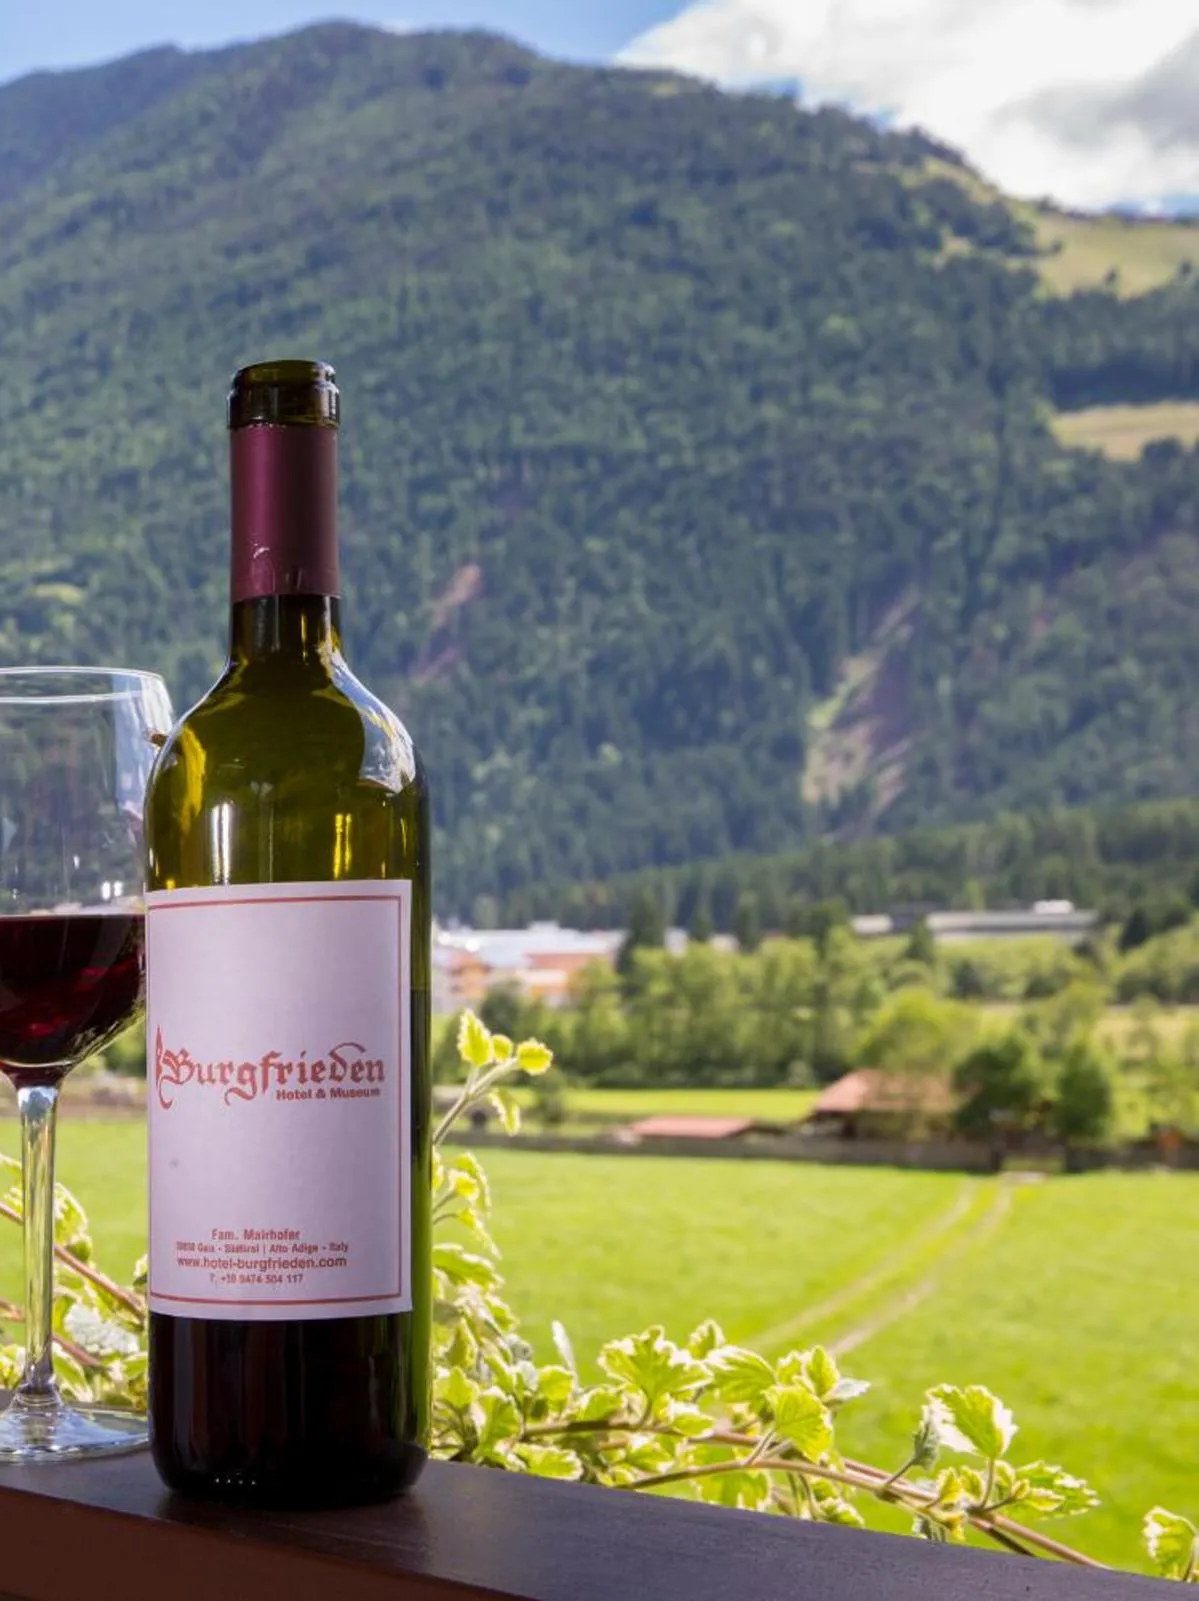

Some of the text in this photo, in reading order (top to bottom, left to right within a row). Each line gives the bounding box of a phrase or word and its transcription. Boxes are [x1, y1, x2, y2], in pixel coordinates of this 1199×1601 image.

[155, 1024, 385, 1110] Burgfrieden
[276, 1086, 381, 1101] Hotel & Museum
[211, 1228, 301, 1241] Fam. Mairhofer
[269, 1243, 288, 1254] Alto
[177, 1255, 348, 1273] www.hotel-burgfrieden.com
[286, 1273, 304, 1284] 117
